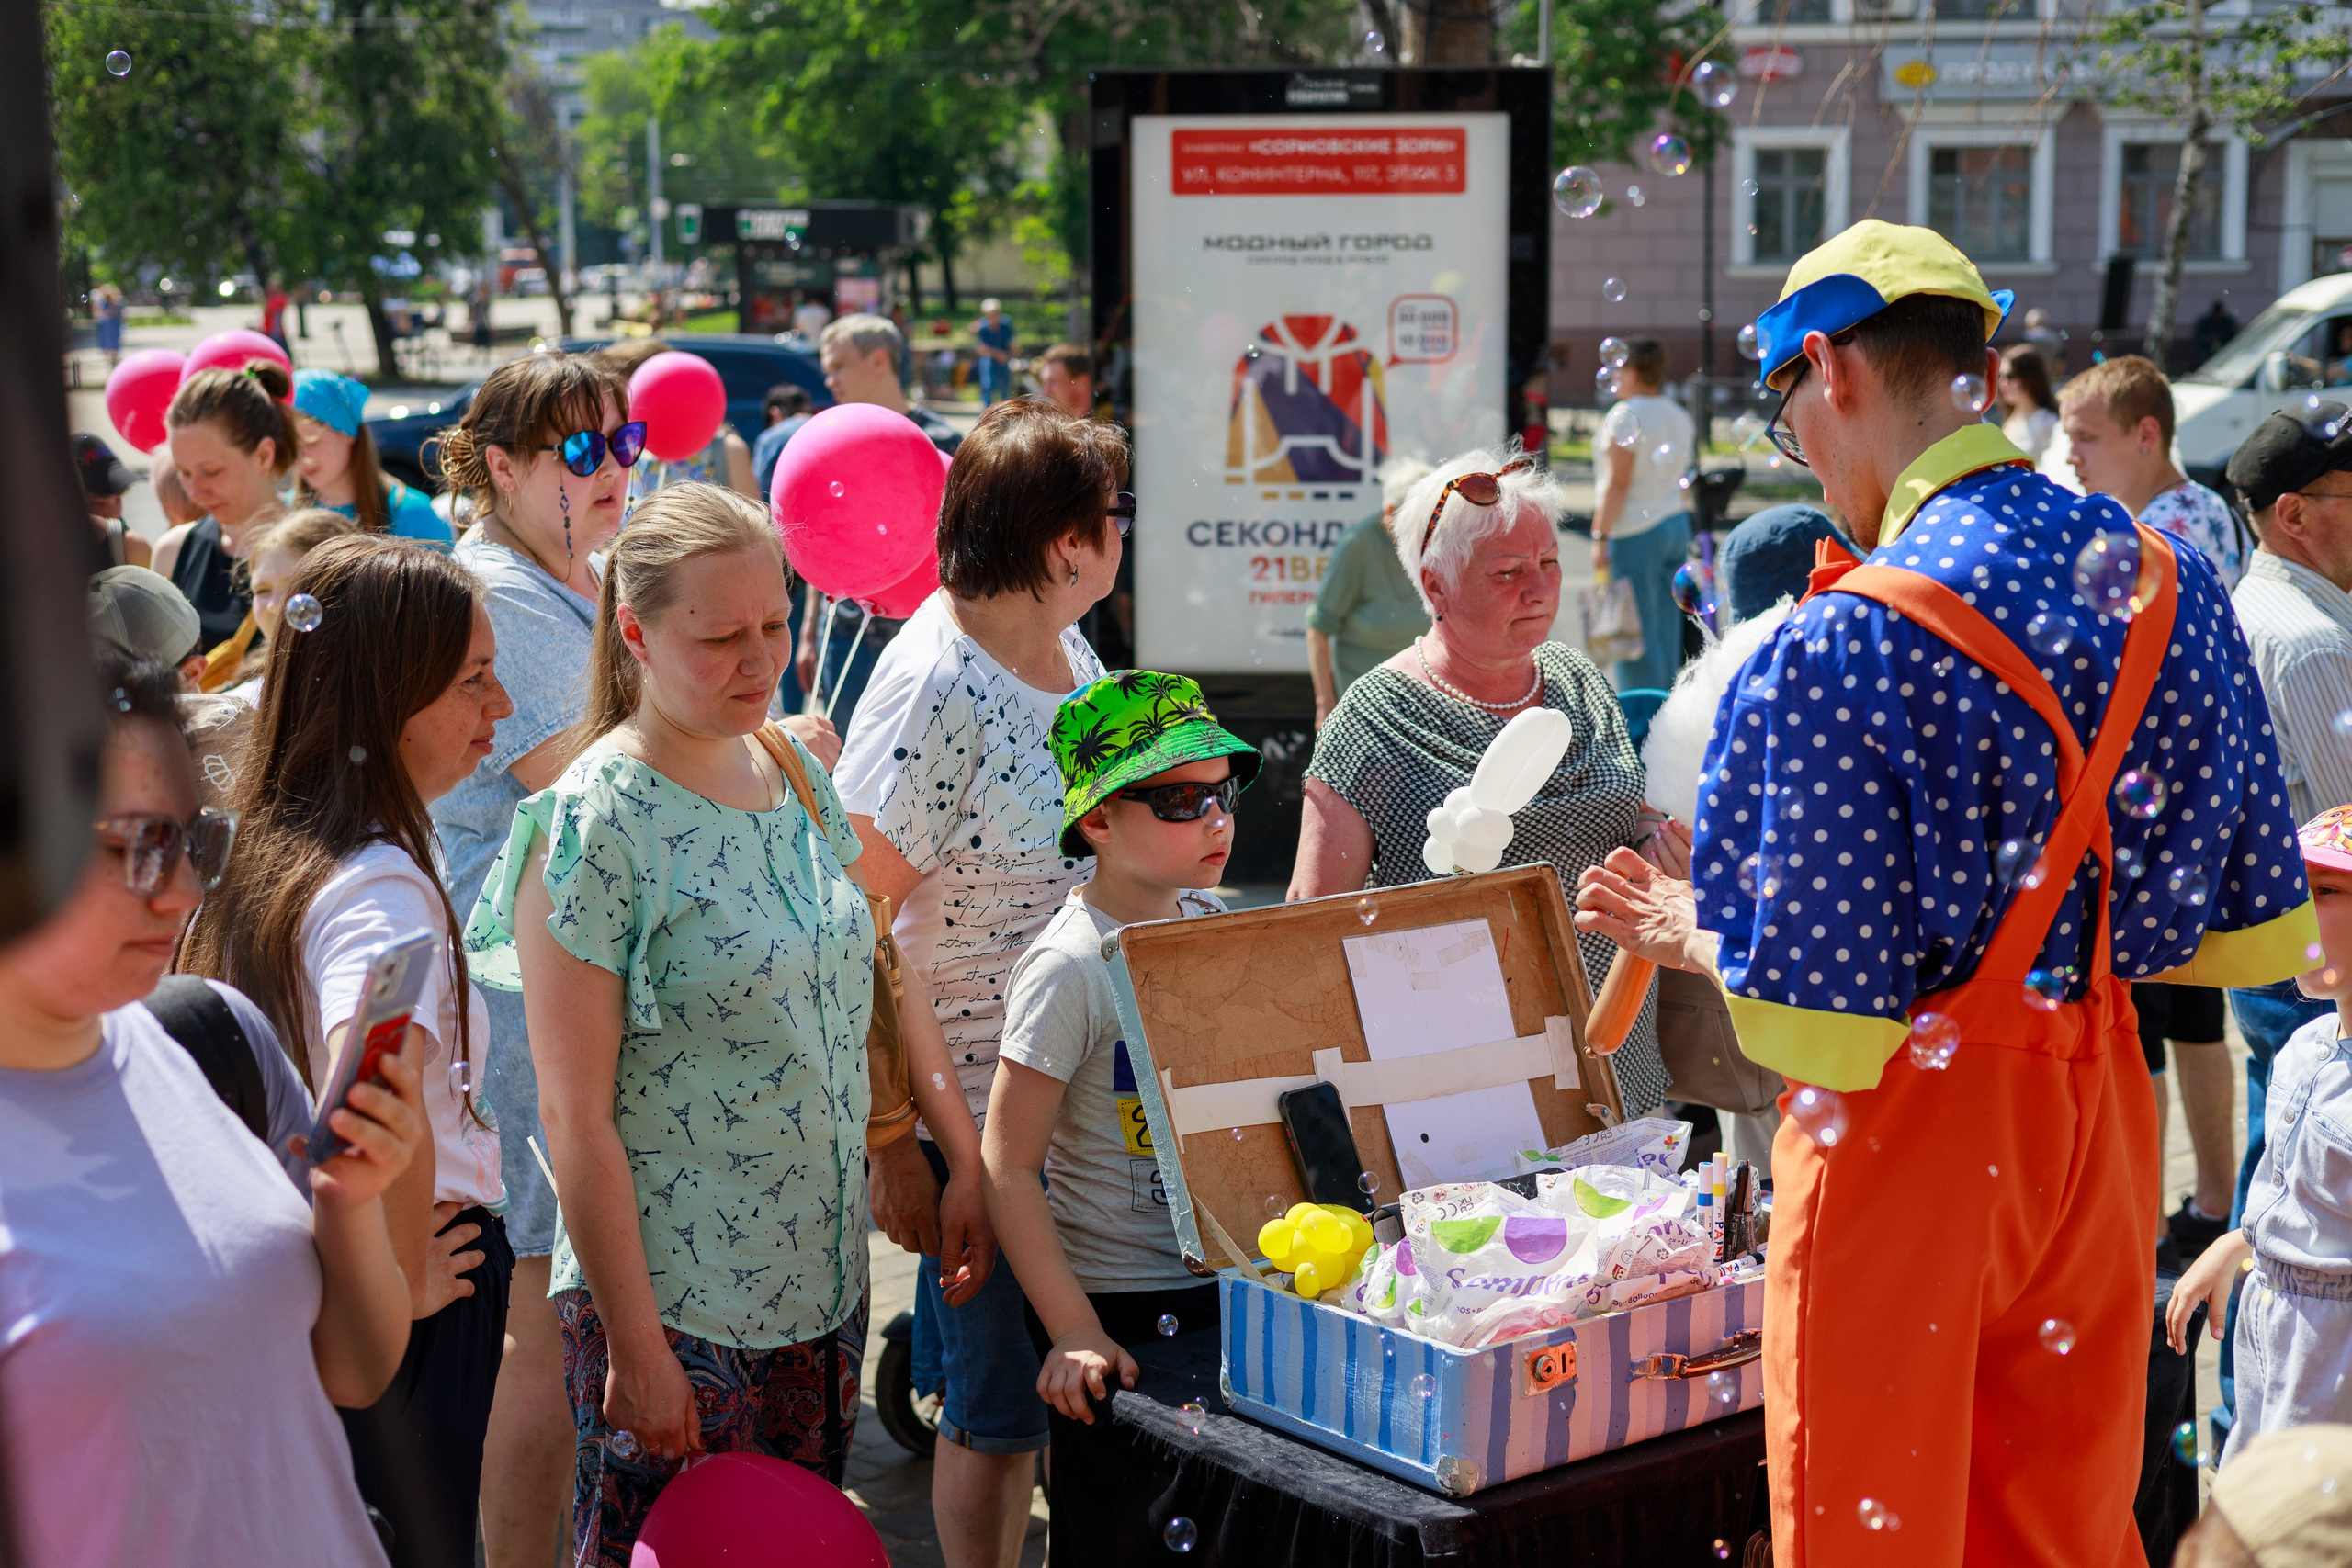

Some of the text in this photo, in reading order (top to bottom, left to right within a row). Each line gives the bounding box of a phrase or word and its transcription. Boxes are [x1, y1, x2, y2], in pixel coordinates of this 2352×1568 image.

[1203, 232, 1432, 251] МОДНЫЙ ГОРОД
[1186, 520, 1345, 551] СЕКОНД
[1250, 555, 1330, 581] 21ВЕ
[1713, 1221, 1724, 1265] PAINT
